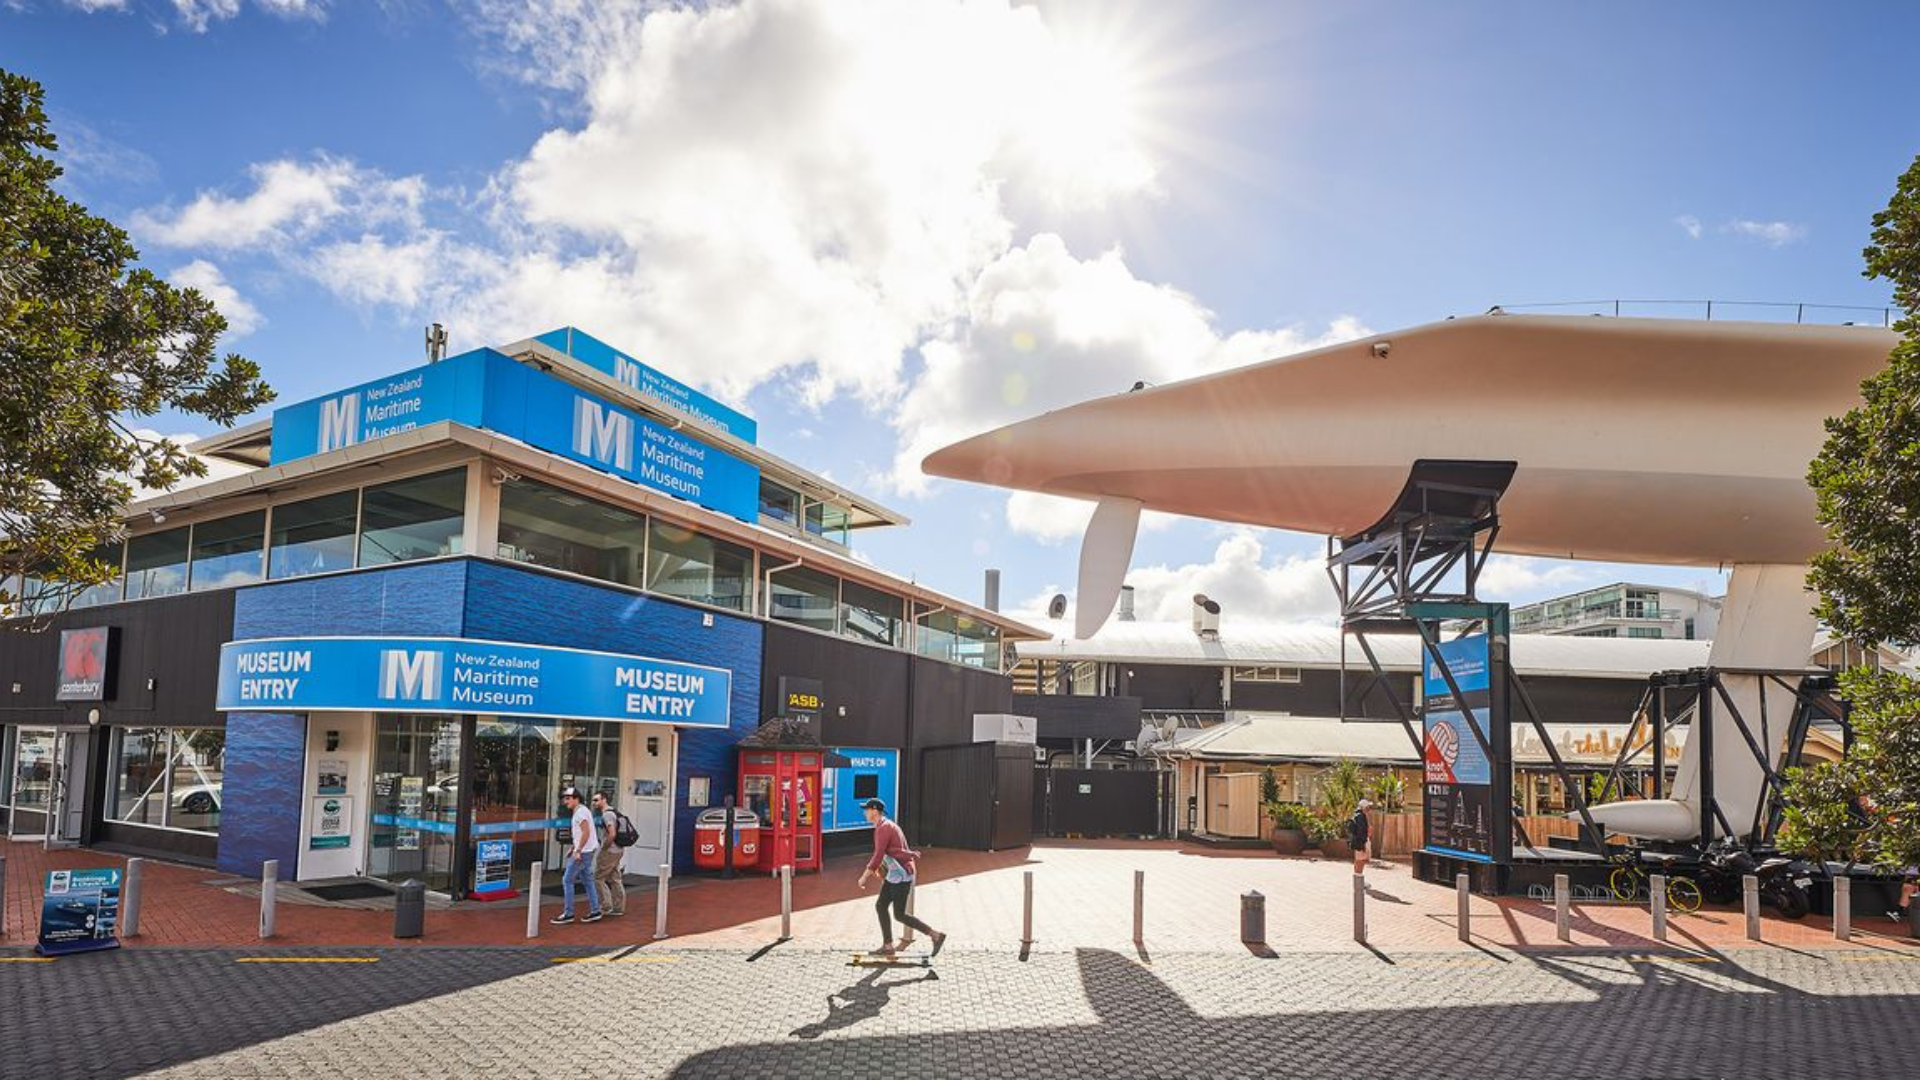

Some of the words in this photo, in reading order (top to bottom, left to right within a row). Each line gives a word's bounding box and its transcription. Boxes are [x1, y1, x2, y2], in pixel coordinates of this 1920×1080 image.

[366, 388, 387, 401] New
[387, 374, 423, 396] Zealand
[642, 370, 659, 384] New
[661, 378, 689, 399] Zealand
[365, 397, 421, 423] Maritime
[642, 381, 688, 413] Maritime
[689, 405, 729, 432] Museum
[642, 425, 667, 443] New
[667, 435, 705, 460] Zealand
[642, 441, 704, 479] Maritime
[641, 462, 700, 496] Museum
[237, 651, 312, 674] MUSEUM
[455, 653, 486, 664] New
[488, 655, 541, 670] Zealand
[241, 678, 299, 699] ENTRY
[453, 667, 539, 688] Maritime
[615, 667, 704, 695] MUSEUM
[452, 686, 534, 705] Museum
[626, 693, 695, 716] ENTRY
[789, 693, 818, 707] ASB
